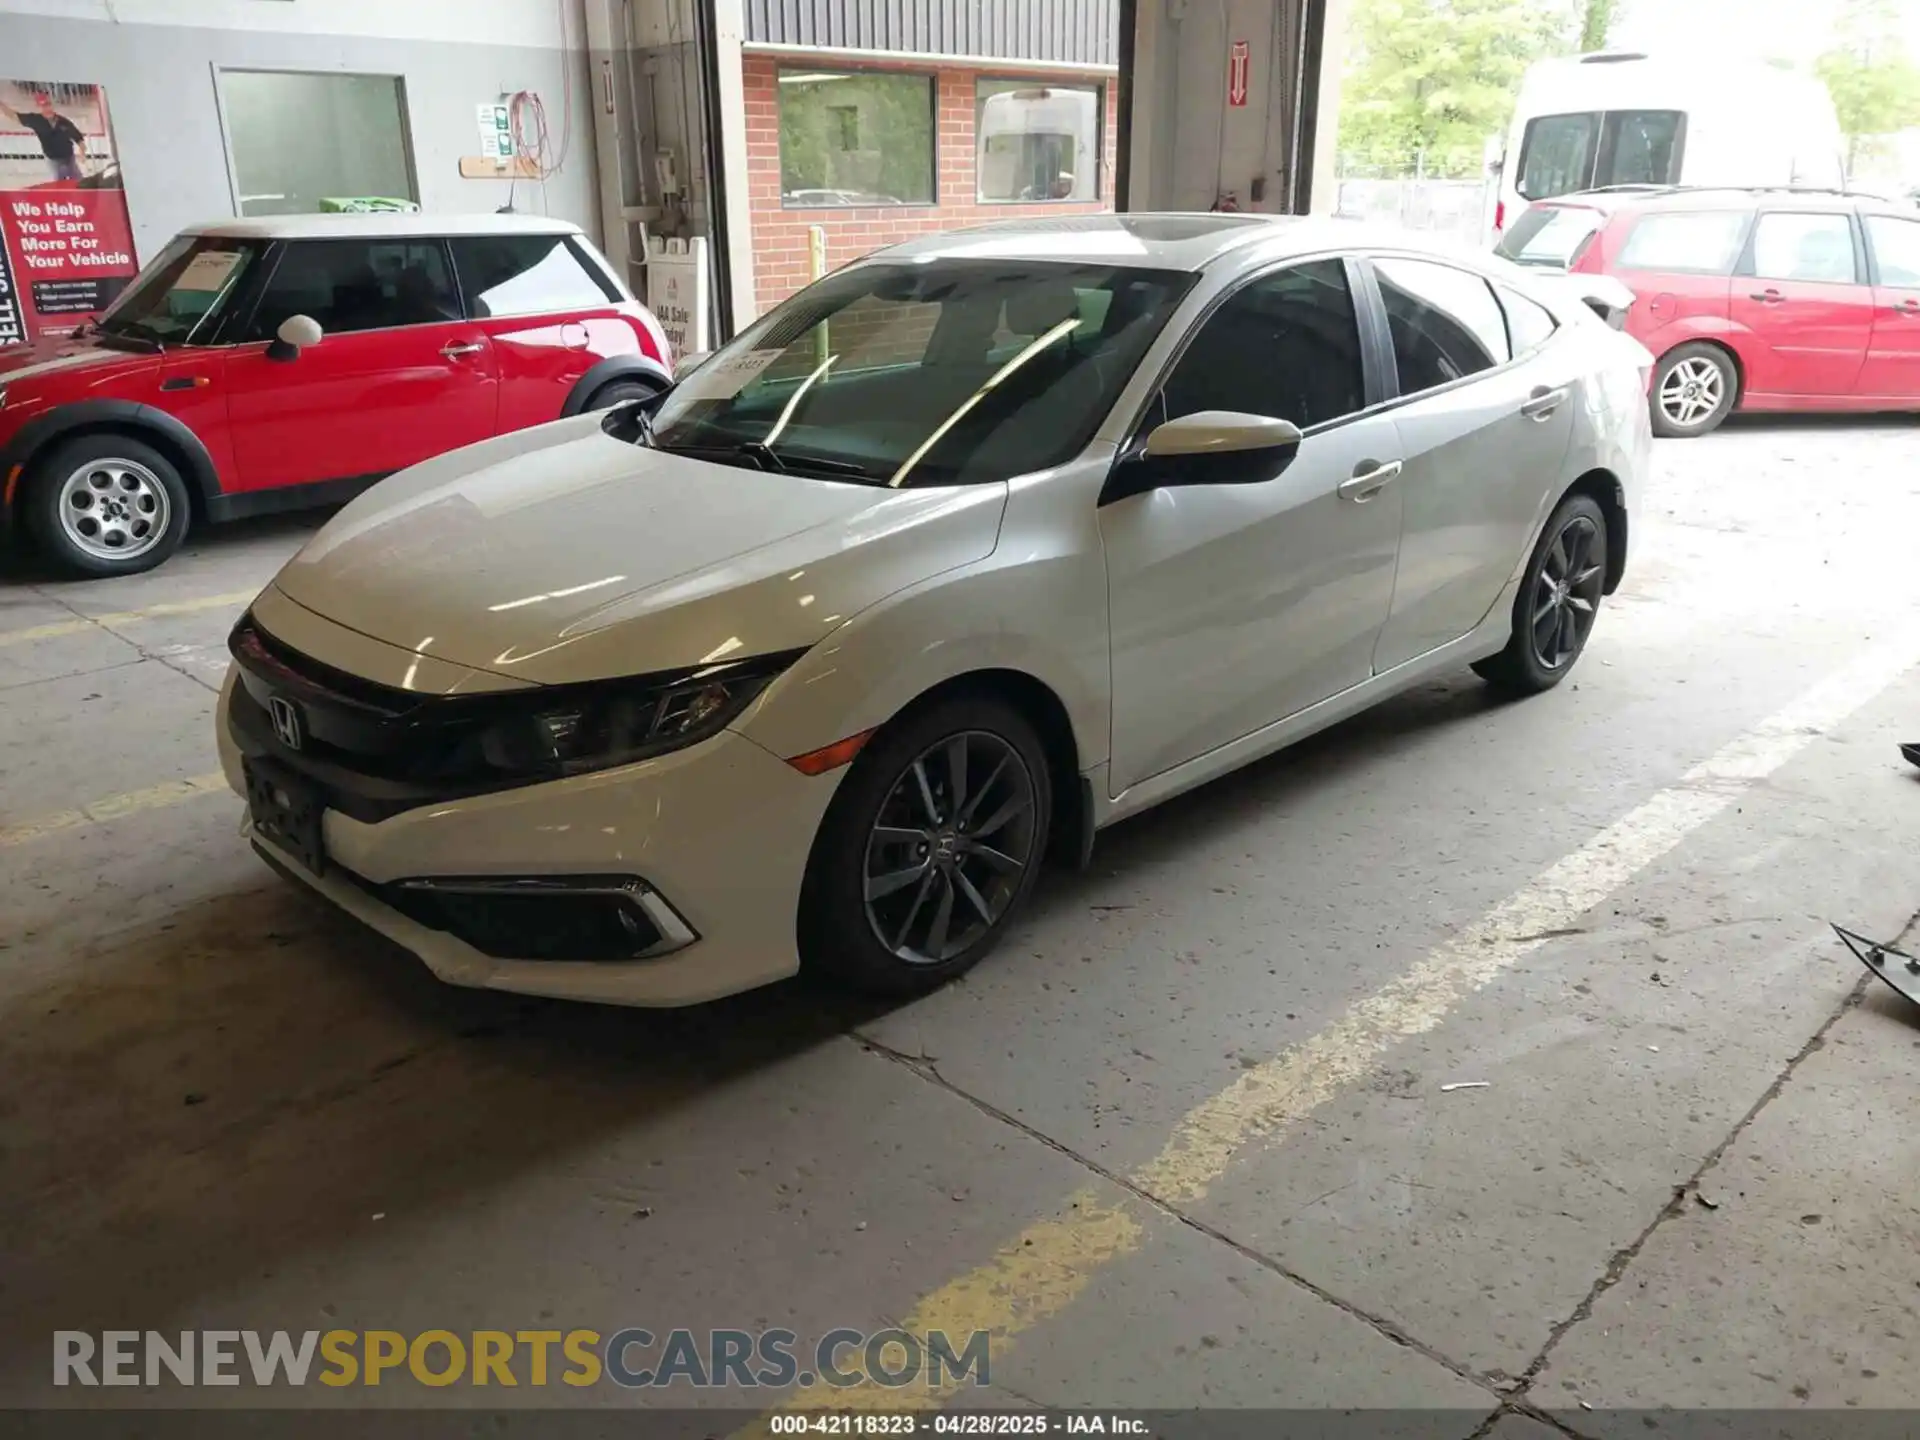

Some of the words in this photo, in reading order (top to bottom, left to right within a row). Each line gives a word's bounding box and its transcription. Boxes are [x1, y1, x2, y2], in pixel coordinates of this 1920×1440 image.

[12, 202, 41, 216] We
[45, 202, 85, 218] Help
[16, 220, 51, 234] You
[55, 219, 95, 233] Earn
[20, 237, 67, 251] More
[70, 235, 98, 249] For
[24, 254, 64, 268] Your
[68, 252, 130, 267] Vehicle
[671, 306, 688, 323] Sale
[662, 327, 686, 346] oday!
